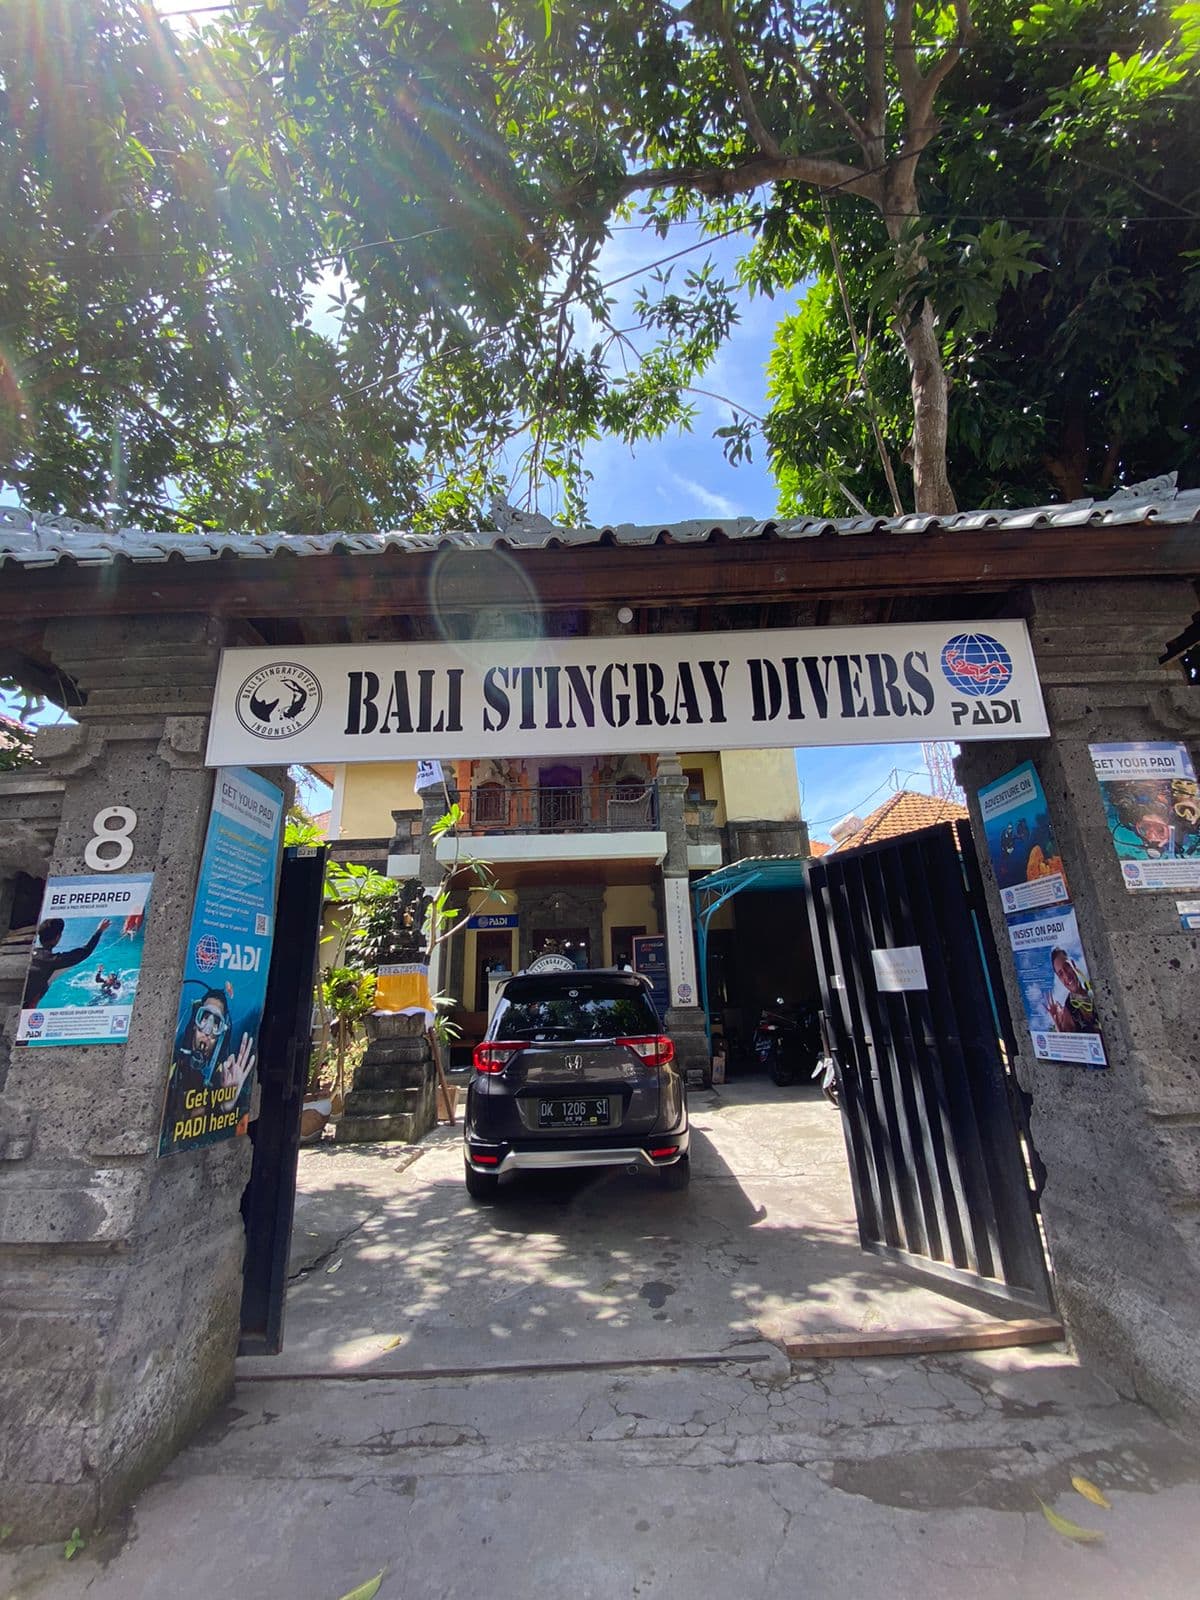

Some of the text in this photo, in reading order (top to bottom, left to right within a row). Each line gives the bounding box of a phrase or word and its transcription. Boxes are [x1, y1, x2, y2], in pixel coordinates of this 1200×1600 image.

[242, 667, 317, 699] BALI STINGRAY DIVERS
[344, 650, 935, 735] BALI STINGRAY DIVERS
[951, 699, 1021, 725] PADI
[251, 721, 302, 736] INDONESIA
[1094, 757, 1176, 769] GET YOUR PADI
[222, 783, 237, 801] GET
[239, 792, 258, 814] YOUR
[259, 804, 275, 821] PADI
[985, 783, 1020, 809] ADVENTURE
[1020, 778, 1032, 792] ON
[85, 806, 137, 871] 8
[51, 891, 131, 905] BE PREPARED
[489, 917, 508, 926] PADI
[1013, 921, 1065, 940] INSIST ON PADI
[220, 942, 262, 972] PADI
[185, 1086, 238, 1110] Get your
[541, 1101, 606, 1116] DK 1206 SI
[173, 1107, 239, 1143] PADI here!
